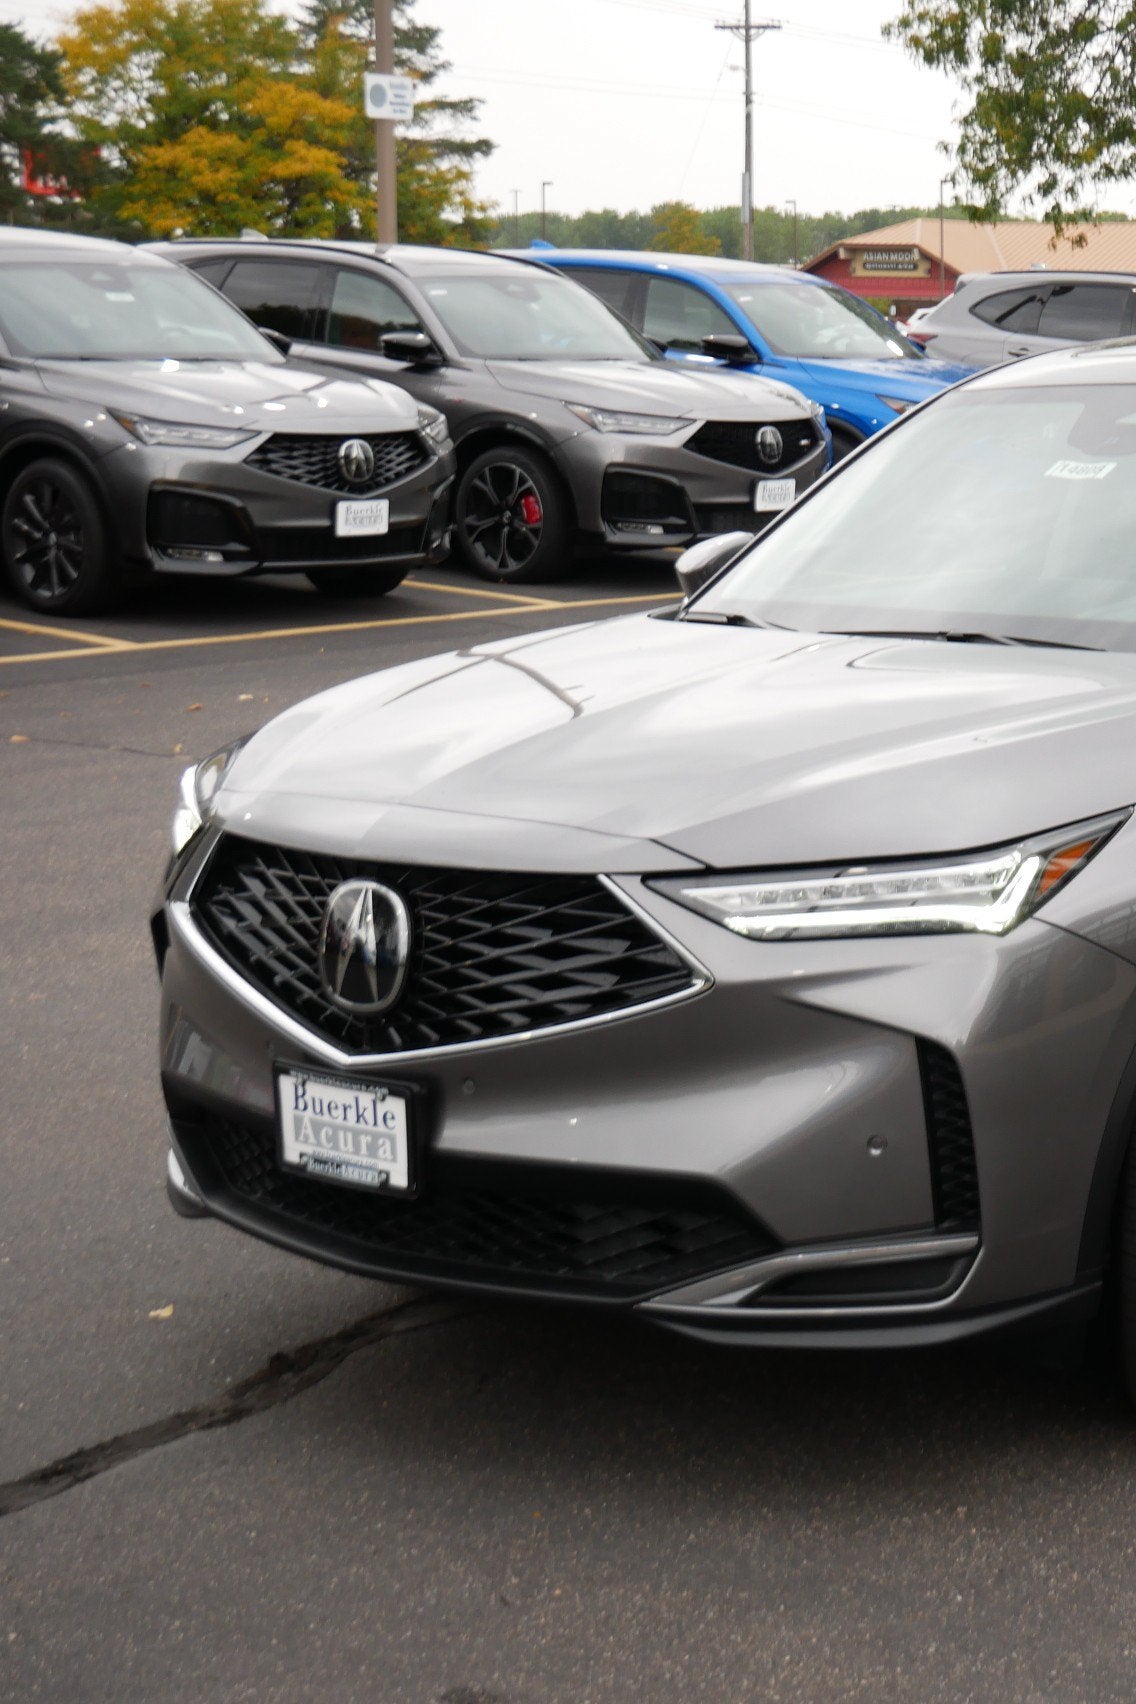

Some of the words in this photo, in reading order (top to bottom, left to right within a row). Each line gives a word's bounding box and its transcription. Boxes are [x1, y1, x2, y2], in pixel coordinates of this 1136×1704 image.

[864, 251, 889, 260] ASIAN
[345, 504, 382, 515] Buerkle
[293, 1084, 396, 1130] Buerkle
[298, 1116, 394, 1161] Acura
